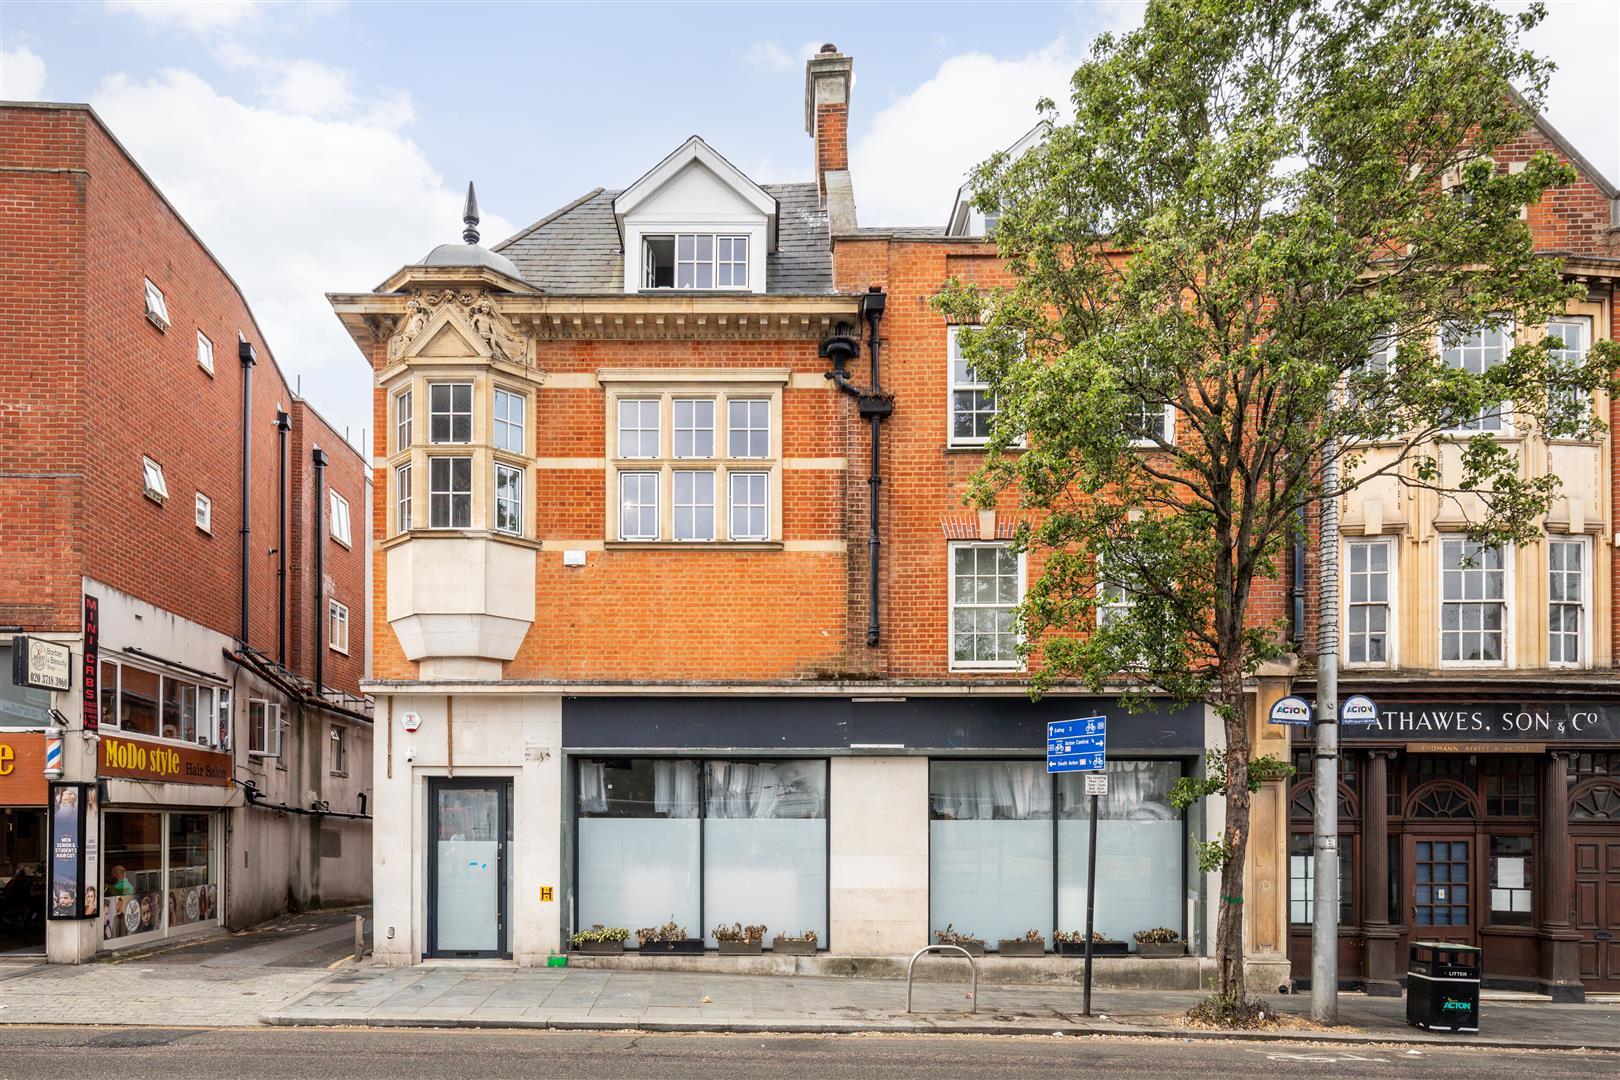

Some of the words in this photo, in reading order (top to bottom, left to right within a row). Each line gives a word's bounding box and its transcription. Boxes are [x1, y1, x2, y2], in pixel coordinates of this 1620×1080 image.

[86, 598, 96, 645] MINI
[85, 653, 95, 699] CABS
[1276, 706, 1308, 715] ACTON
[1346, 705, 1373, 713] ACTON
[1502, 712, 1549, 731] SON
[1557, 720, 1565, 734] &
[105, 739, 146, 770] MoDo
[150, 747, 180, 776] style
[186, 762, 204, 776] Hair
[206, 764, 228, 779] Salon
[1444, 1002, 1471, 1010] ACTON
